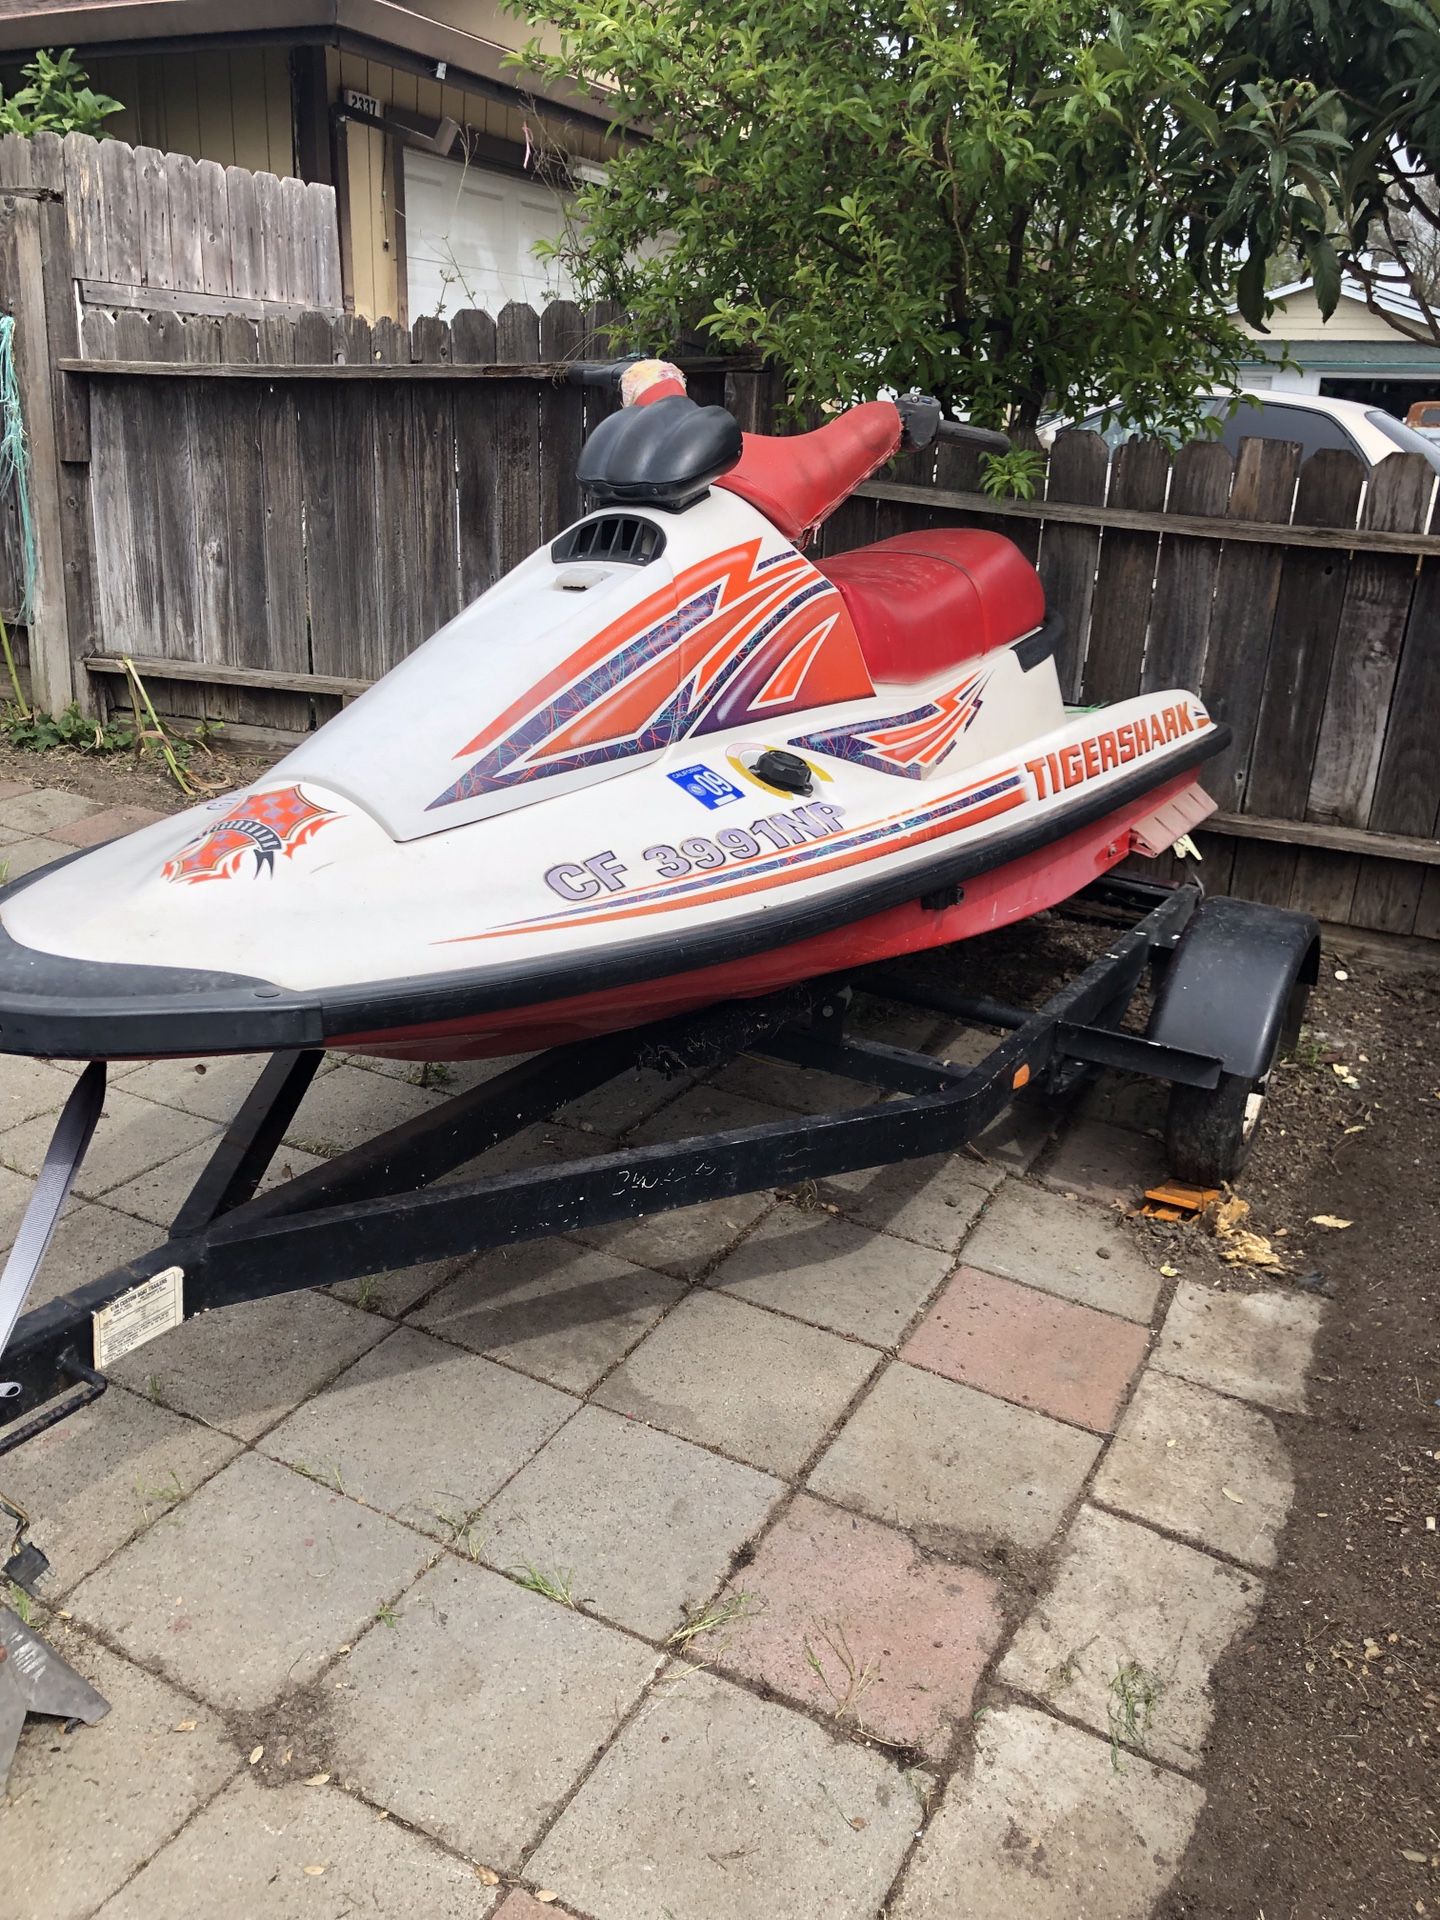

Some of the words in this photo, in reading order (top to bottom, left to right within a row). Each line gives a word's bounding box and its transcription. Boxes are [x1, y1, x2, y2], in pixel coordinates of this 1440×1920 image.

[352, 94, 376, 116] 2337
[1024, 701, 1194, 801] TIGERSHARK
[693, 771, 733, 796] 09
[544, 850, 628, 901] CF
[643, 802, 846, 879] 3991NP
